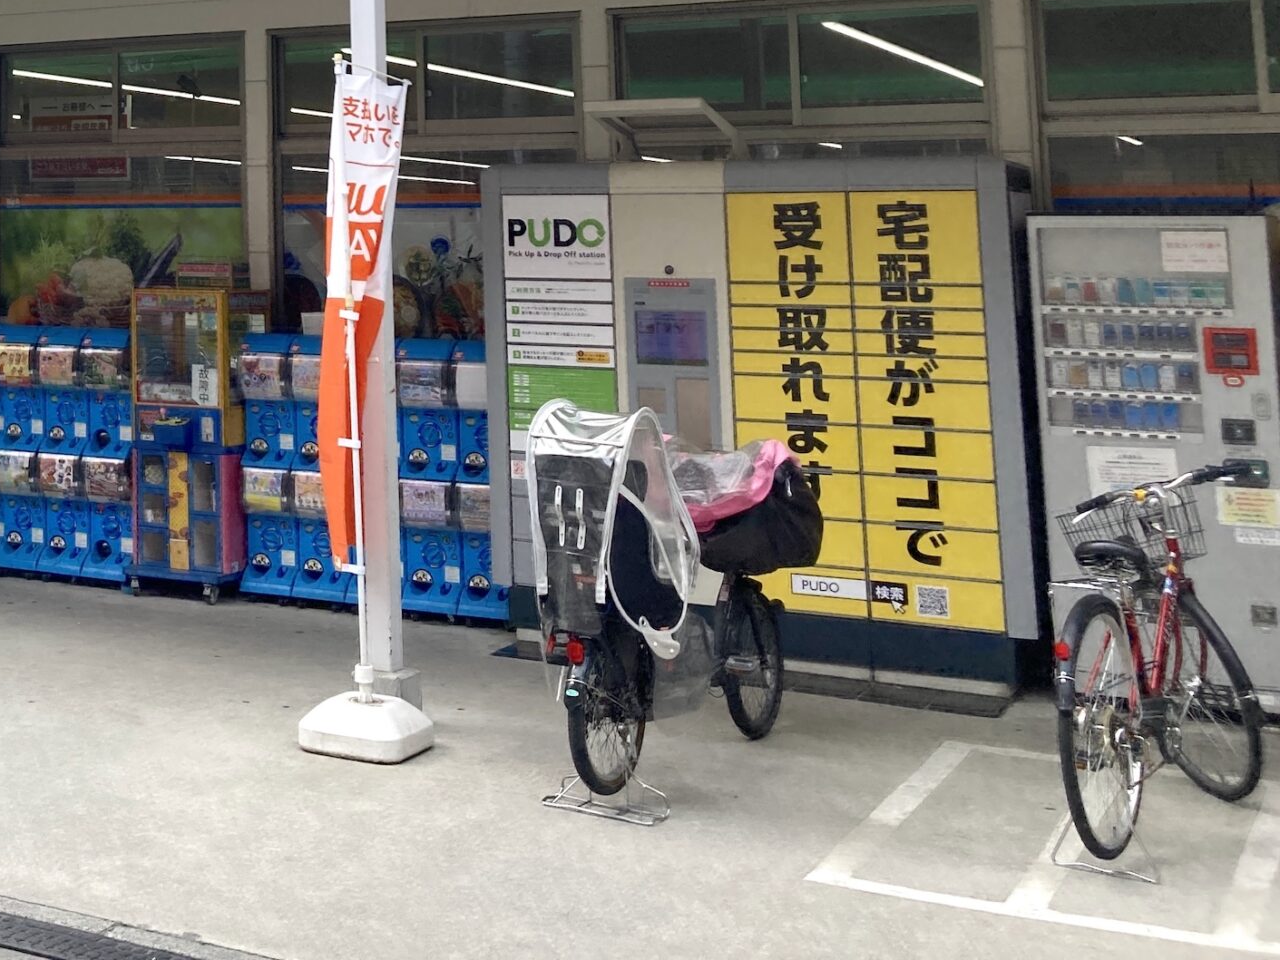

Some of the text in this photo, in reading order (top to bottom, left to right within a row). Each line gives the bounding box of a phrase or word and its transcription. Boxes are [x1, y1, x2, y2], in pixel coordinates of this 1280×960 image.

[507, 217, 606, 248] PUDO
[543, 251, 562, 259] Drop
[876, 200, 949, 567] 宅配便がココで
[801, 579, 840, 593] PUDO
[875, 585, 905, 601] 検索
